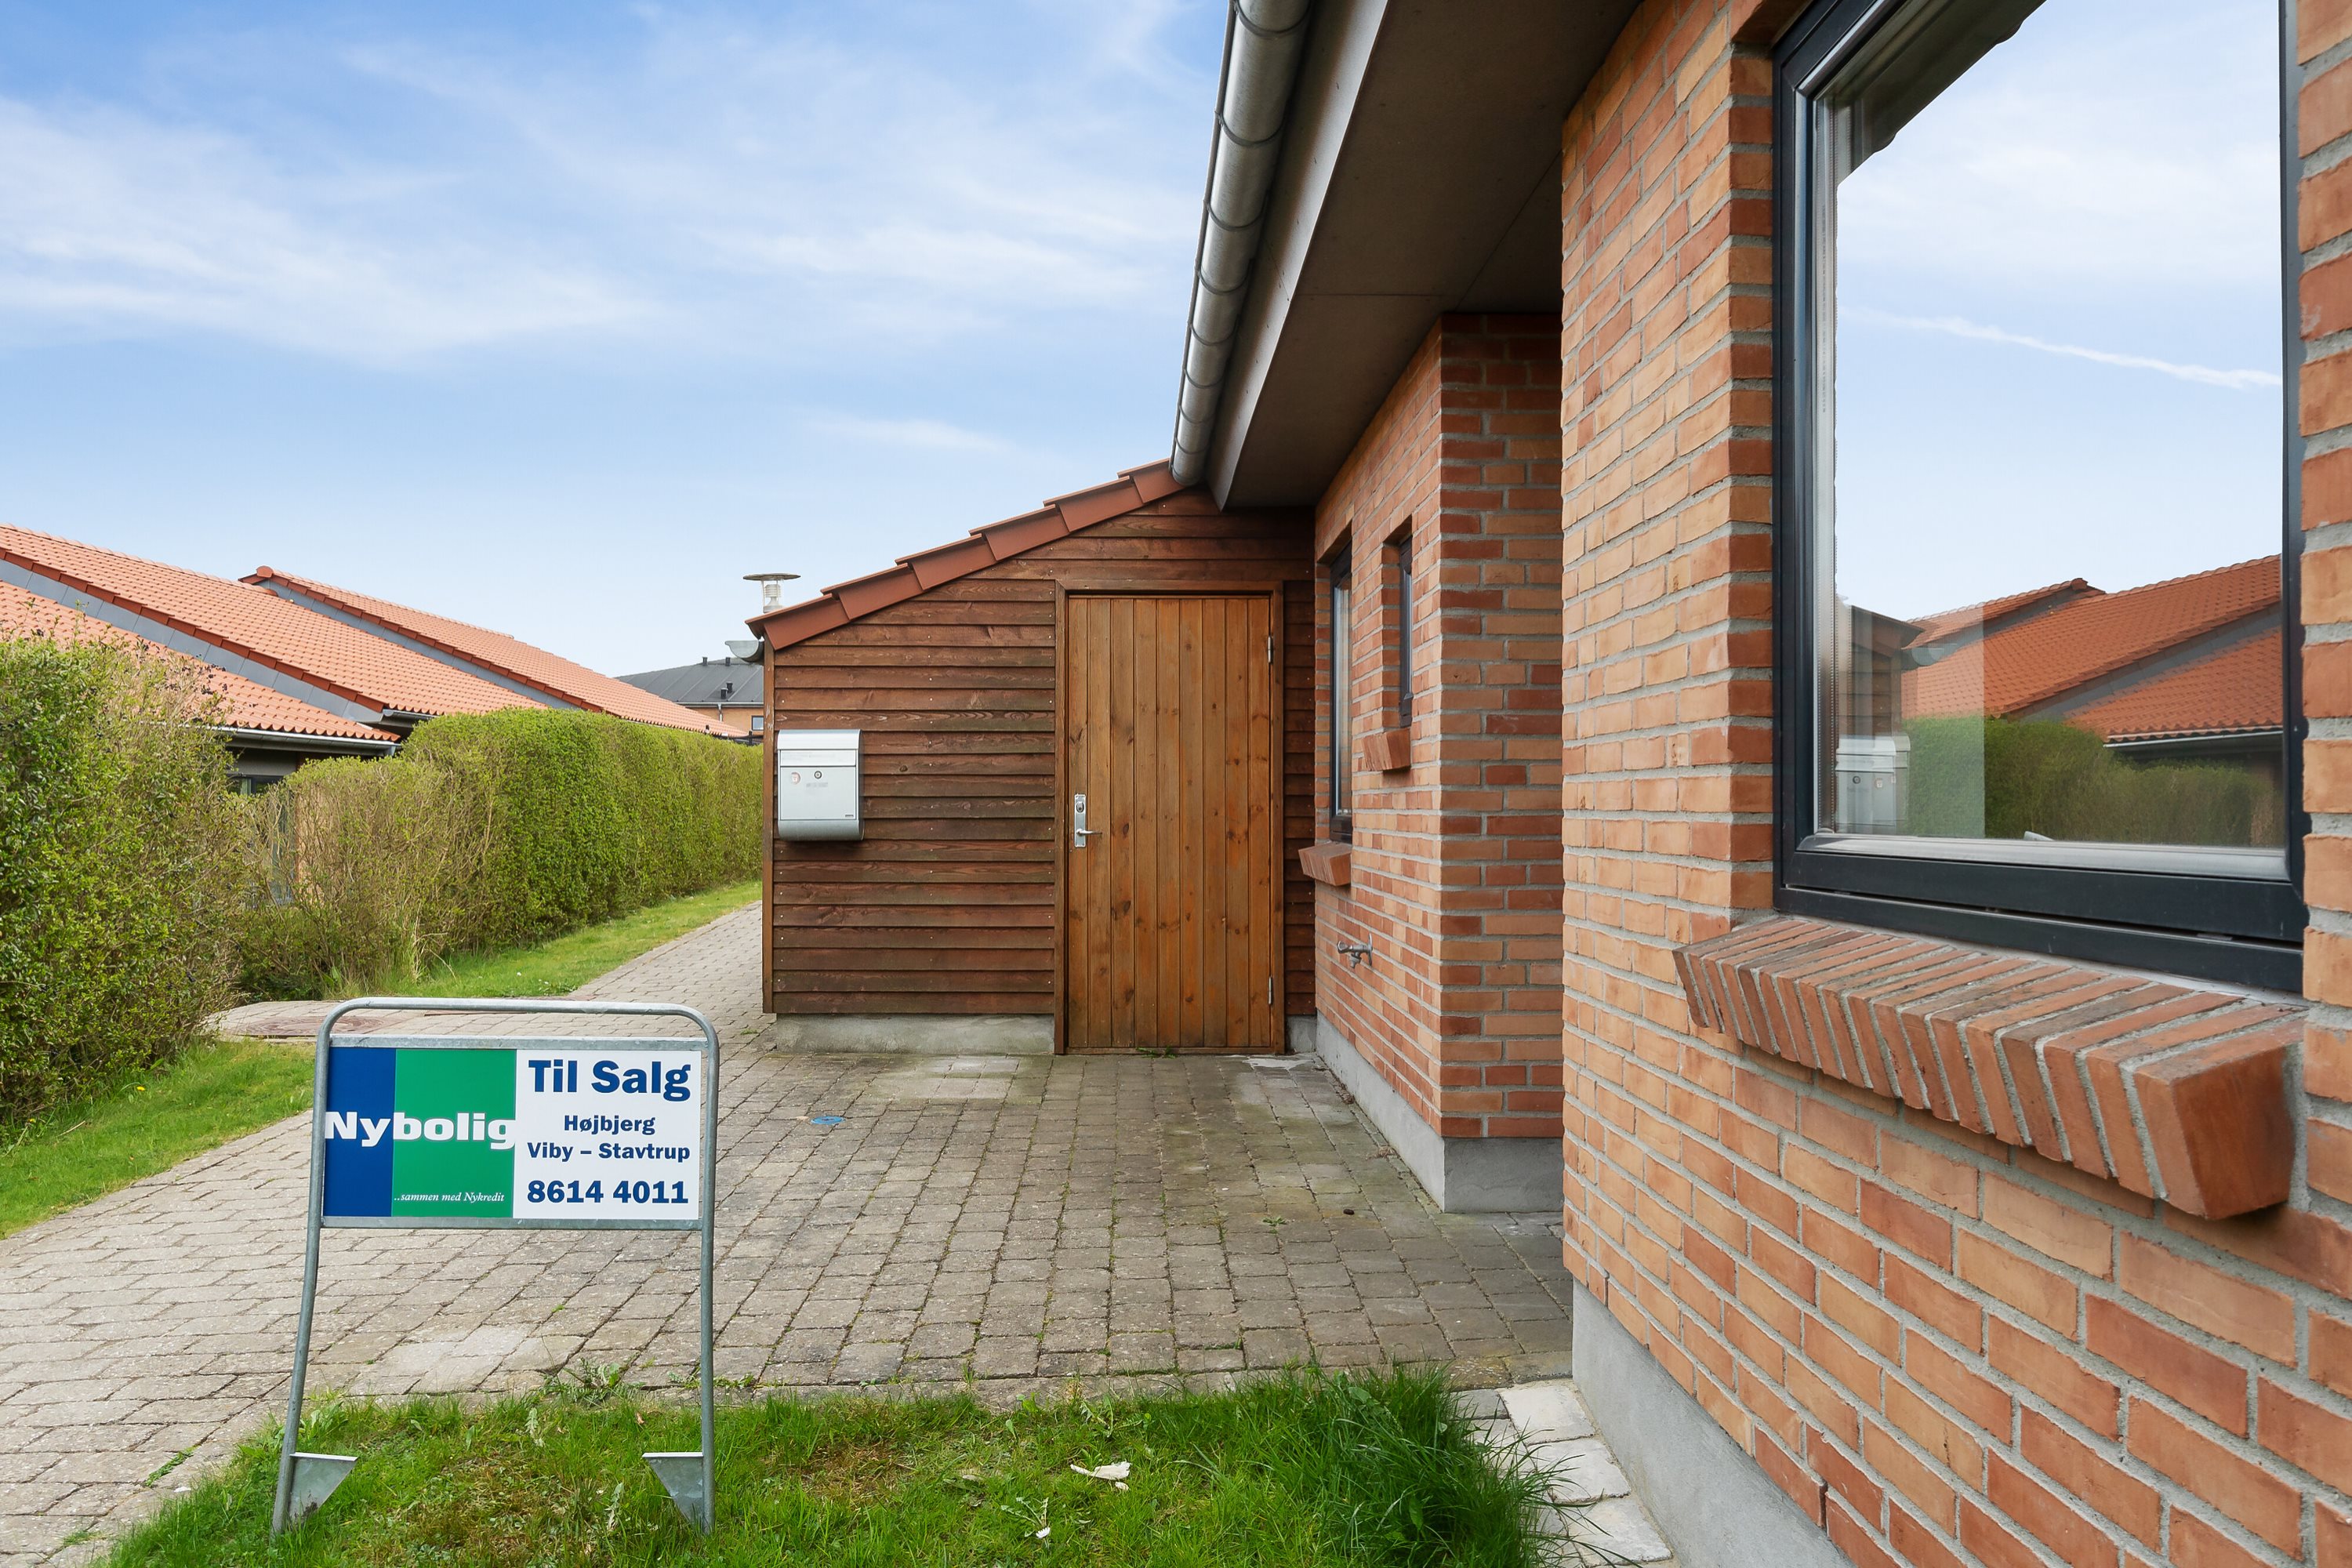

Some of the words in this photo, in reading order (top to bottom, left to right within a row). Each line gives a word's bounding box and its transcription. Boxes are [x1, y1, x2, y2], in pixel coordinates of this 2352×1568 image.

[528, 1059, 578, 1093] Til
[591, 1060, 691, 1102] Salg
[325, 1111, 516, 1150] Nybolig
[564, 1115, 656, 1136] Højbjerg
[527, 1142, 574, 1163] Viby
[598, 1142, 691, 1163] Stavtrup
[441, 1192, 462, 1202] med
[463, 1192, 505, 1204] Nykredit
[527, 1180, 604, 1203] 8614
[612, 1180, 689, 1204] 4011
